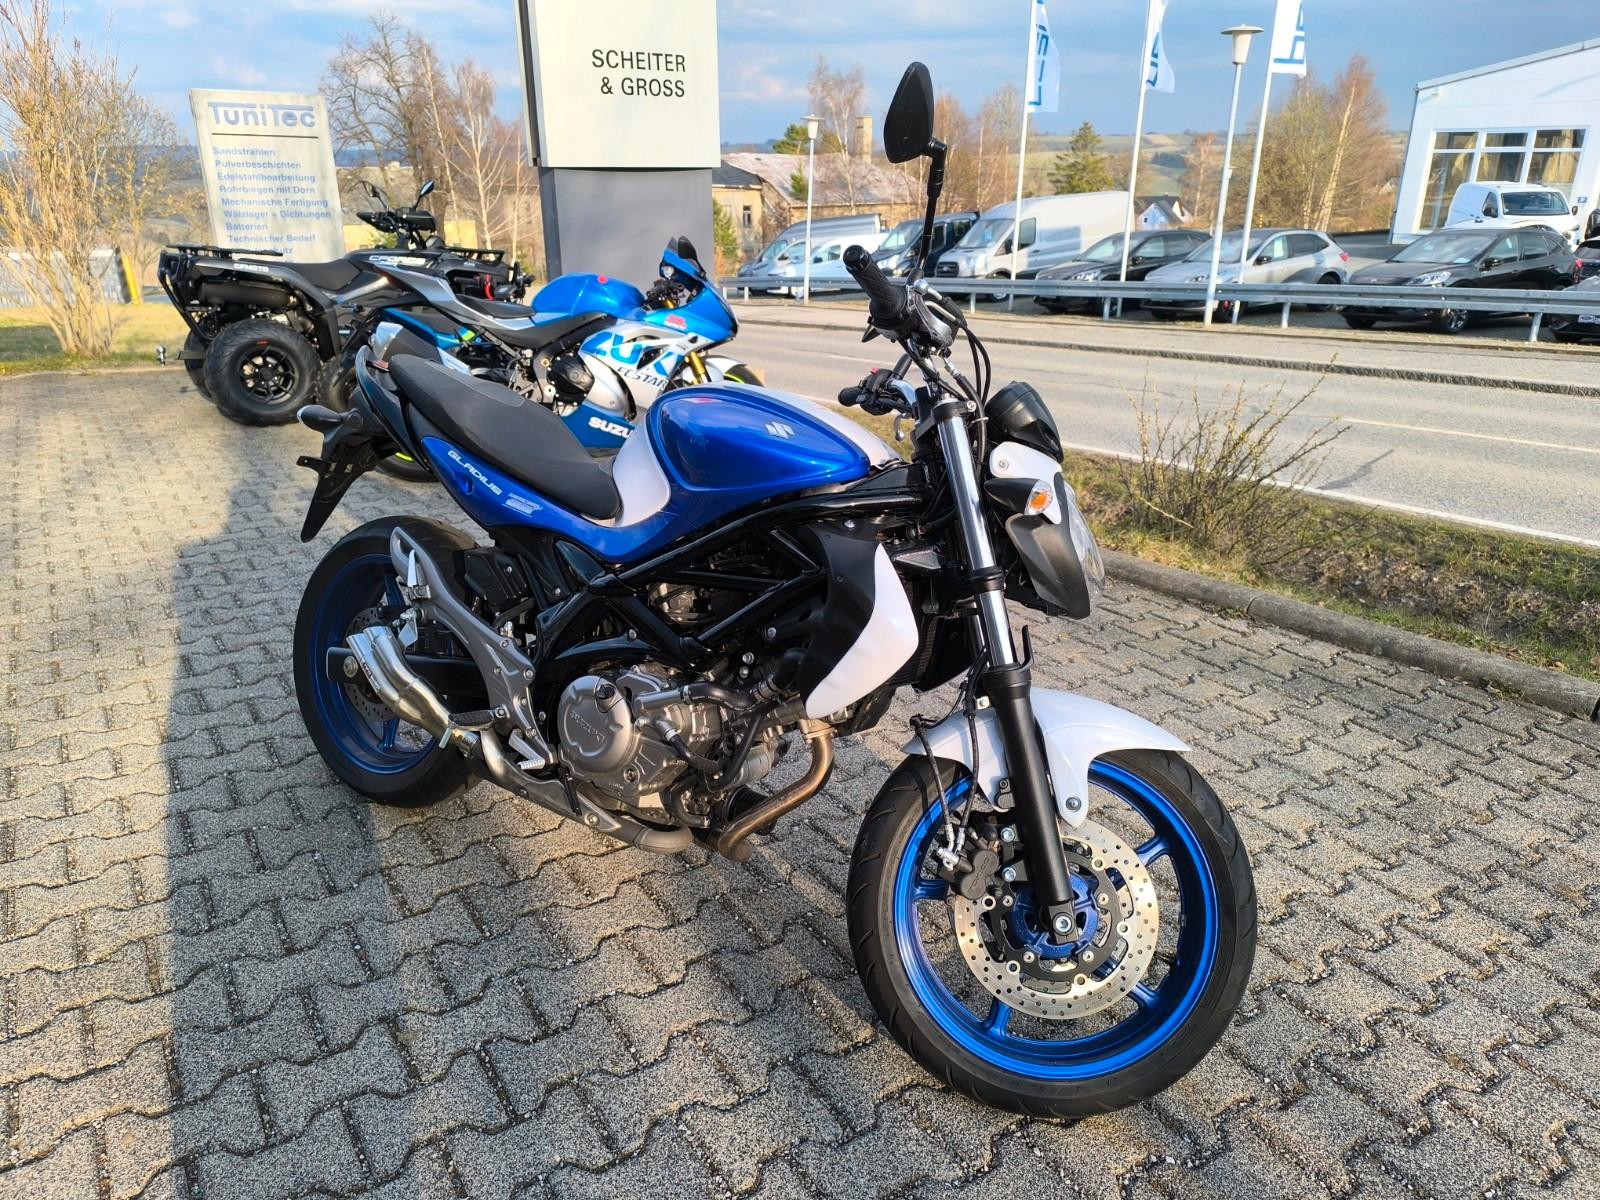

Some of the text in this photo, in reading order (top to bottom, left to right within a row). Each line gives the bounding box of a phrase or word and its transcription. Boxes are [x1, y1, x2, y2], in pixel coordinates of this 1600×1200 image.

[592, 49, 685, 72] SCHEITER
[600, 77, 685, 97] & GROSS
[212, 146, 276, 156] Sandstrahlen
[215, 159, 302, 169] Pulverbeschichten
[217, 172, 316, 183] Edelstahlbearbeitung
[219, 185, 274, 195] Rohrbiegen
[293, 186, 315, 194] Dorn
[221, 198, 329, 208] Mechanische Fertigung
[279, 210, 332, 219] Dichtungen
[225, 222, 268, 231] Batterien
[228, 234, 316, 243] Technischer Bedarf
[447, 449, 503, 496] GLADIUS
